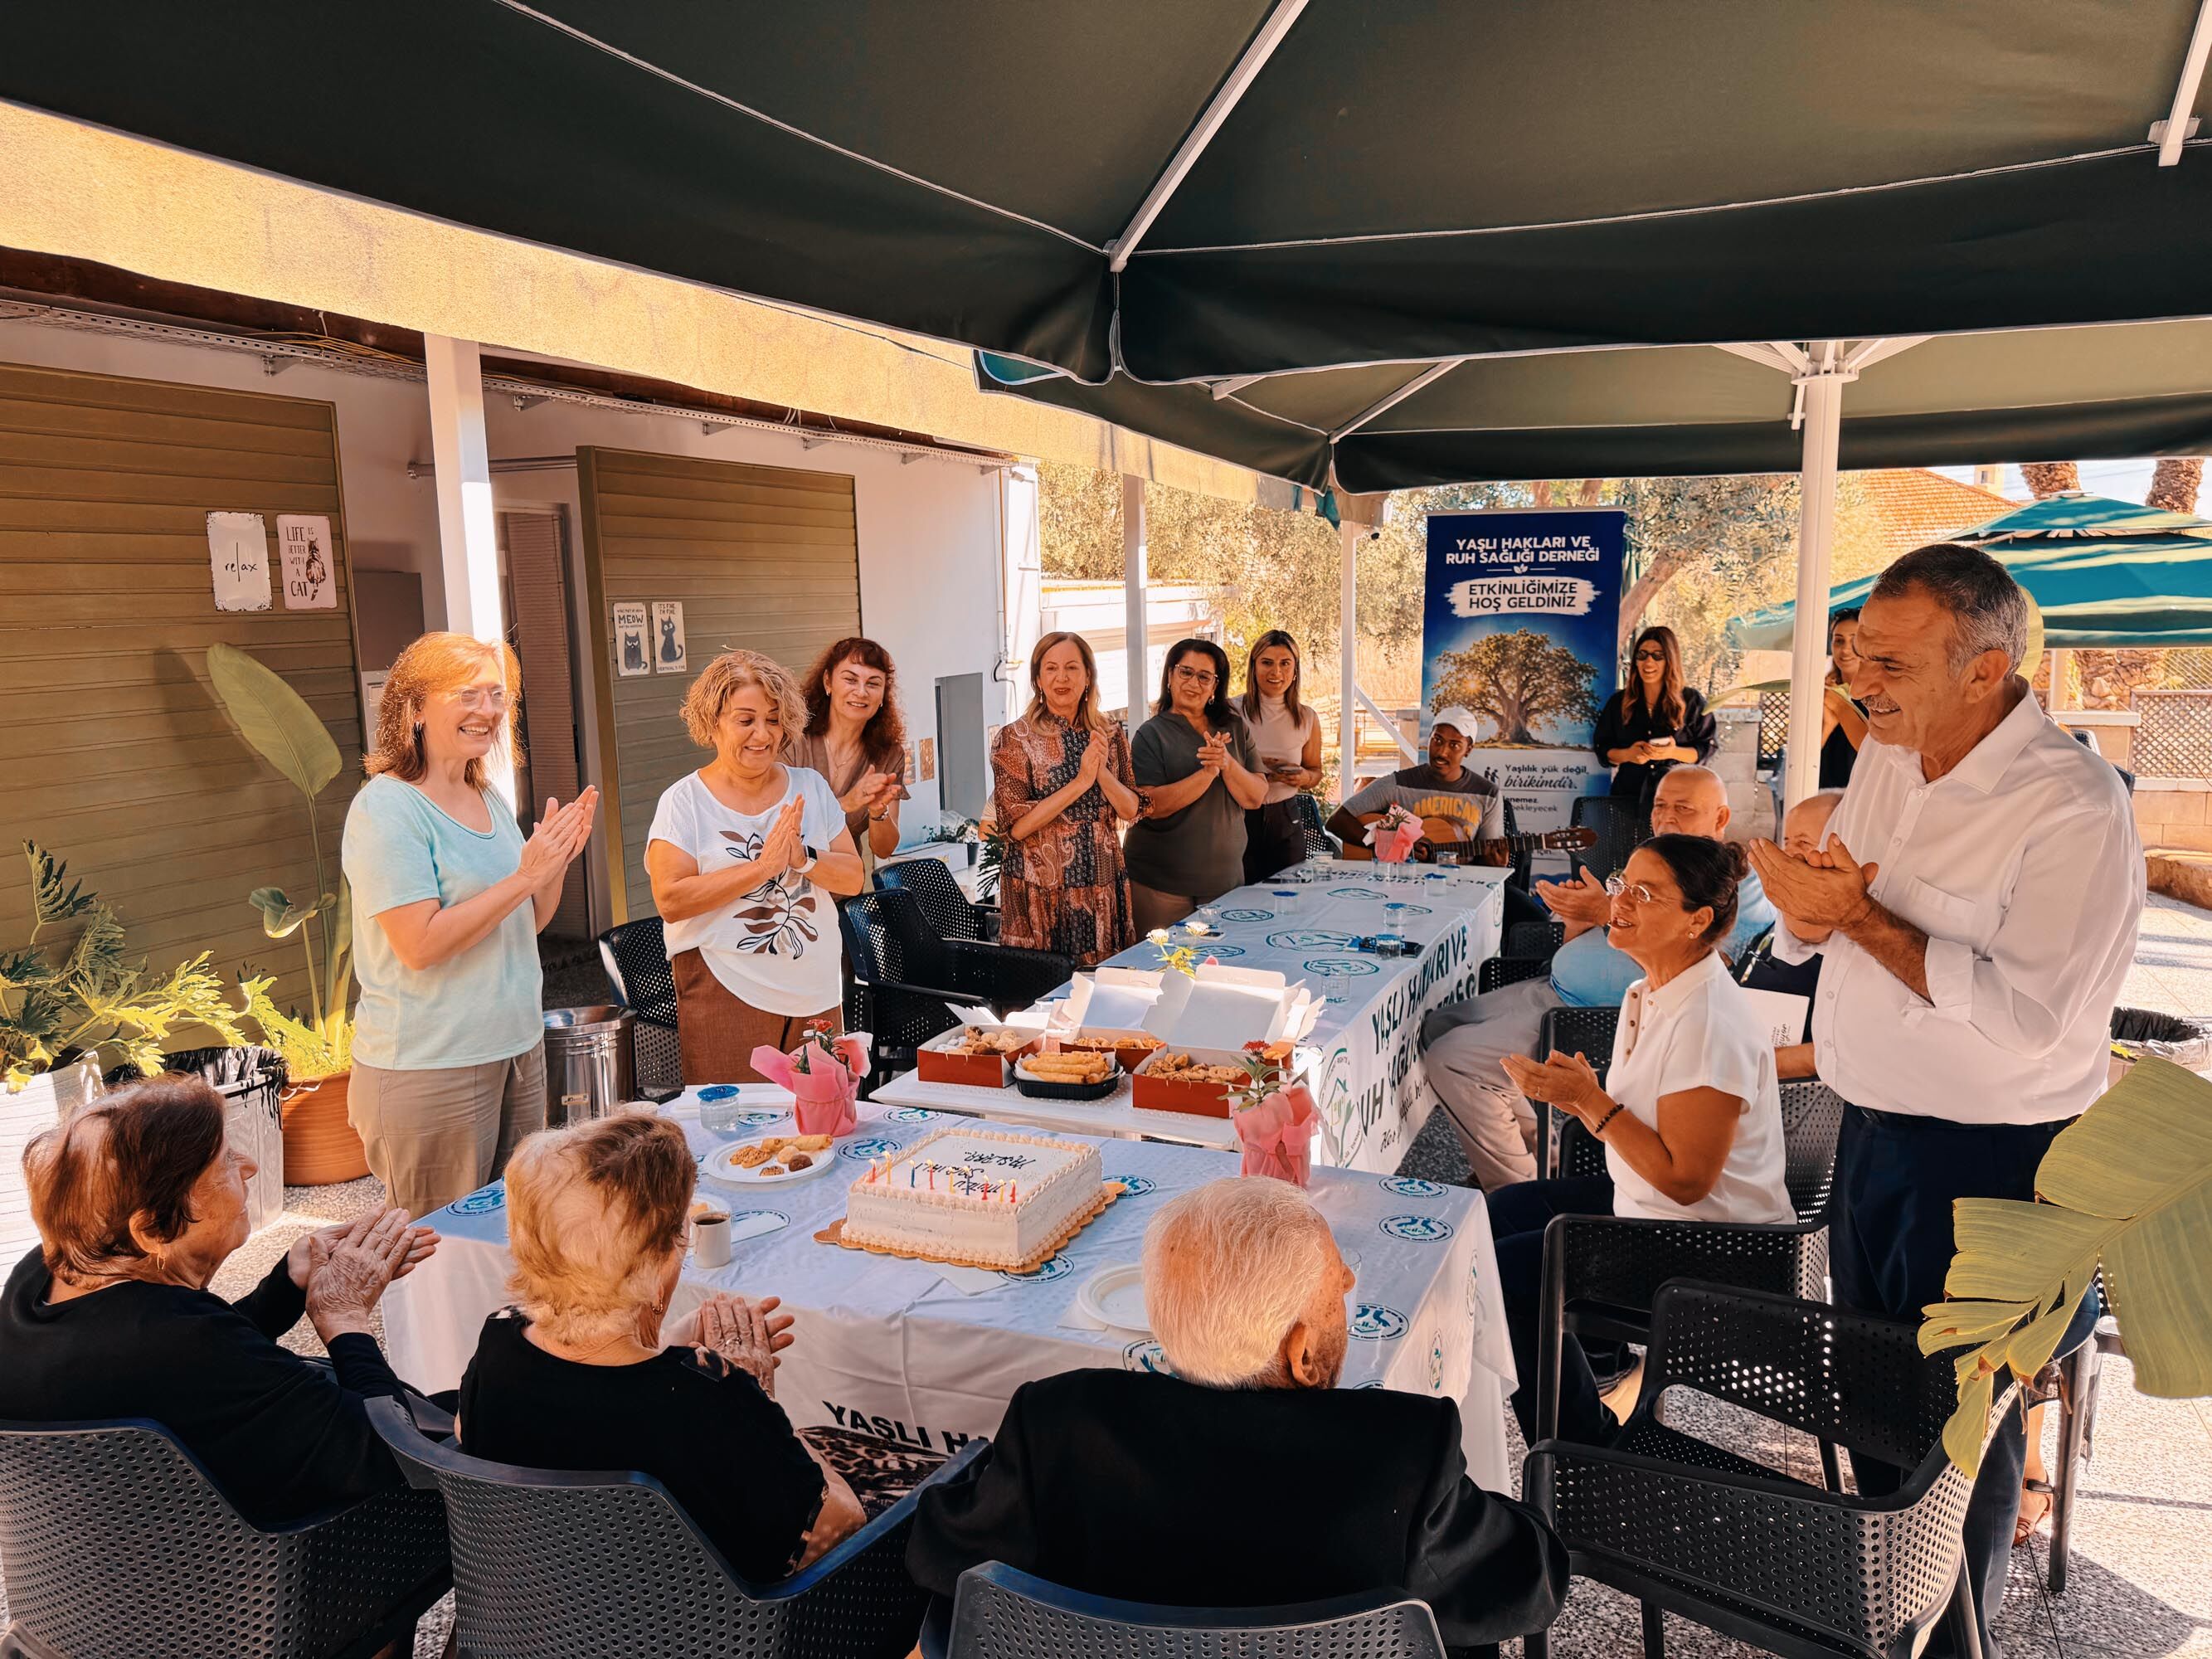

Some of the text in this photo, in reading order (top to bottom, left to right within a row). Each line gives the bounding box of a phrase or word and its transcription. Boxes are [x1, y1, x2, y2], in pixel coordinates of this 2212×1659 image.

[286, 526, 314, 542] LIFE IS
[288, 544, 307, 555] BETTER
[1456, 535, 1591, 553] YAŞLI HAKLARI VE
[225, 542, 258, 582] relax
[289, 557, 306, 566] WITH
[1446, 547, 1600, 565] RUH SAĞLIĞI DERNEĞİ
[295, 568, 300, 577] A
[290, 581, 309, 597] CAT
[1469, 579, 1578, 596] ETKİNLİĞİMİZE
[1469, 591, 1576, 612] HOŞ GELDİNİZ
[618, 614, 644, 625] MEOW
[1505, 764, 1538, 775] Yaşlılık
[1541, 765, 1558, 774] yük
[1504, 775, 1578, 789] birikimdir.
[1373, 985, 1404, 1055] YAŞLI
[1451, 925, 1467, 967] VE
